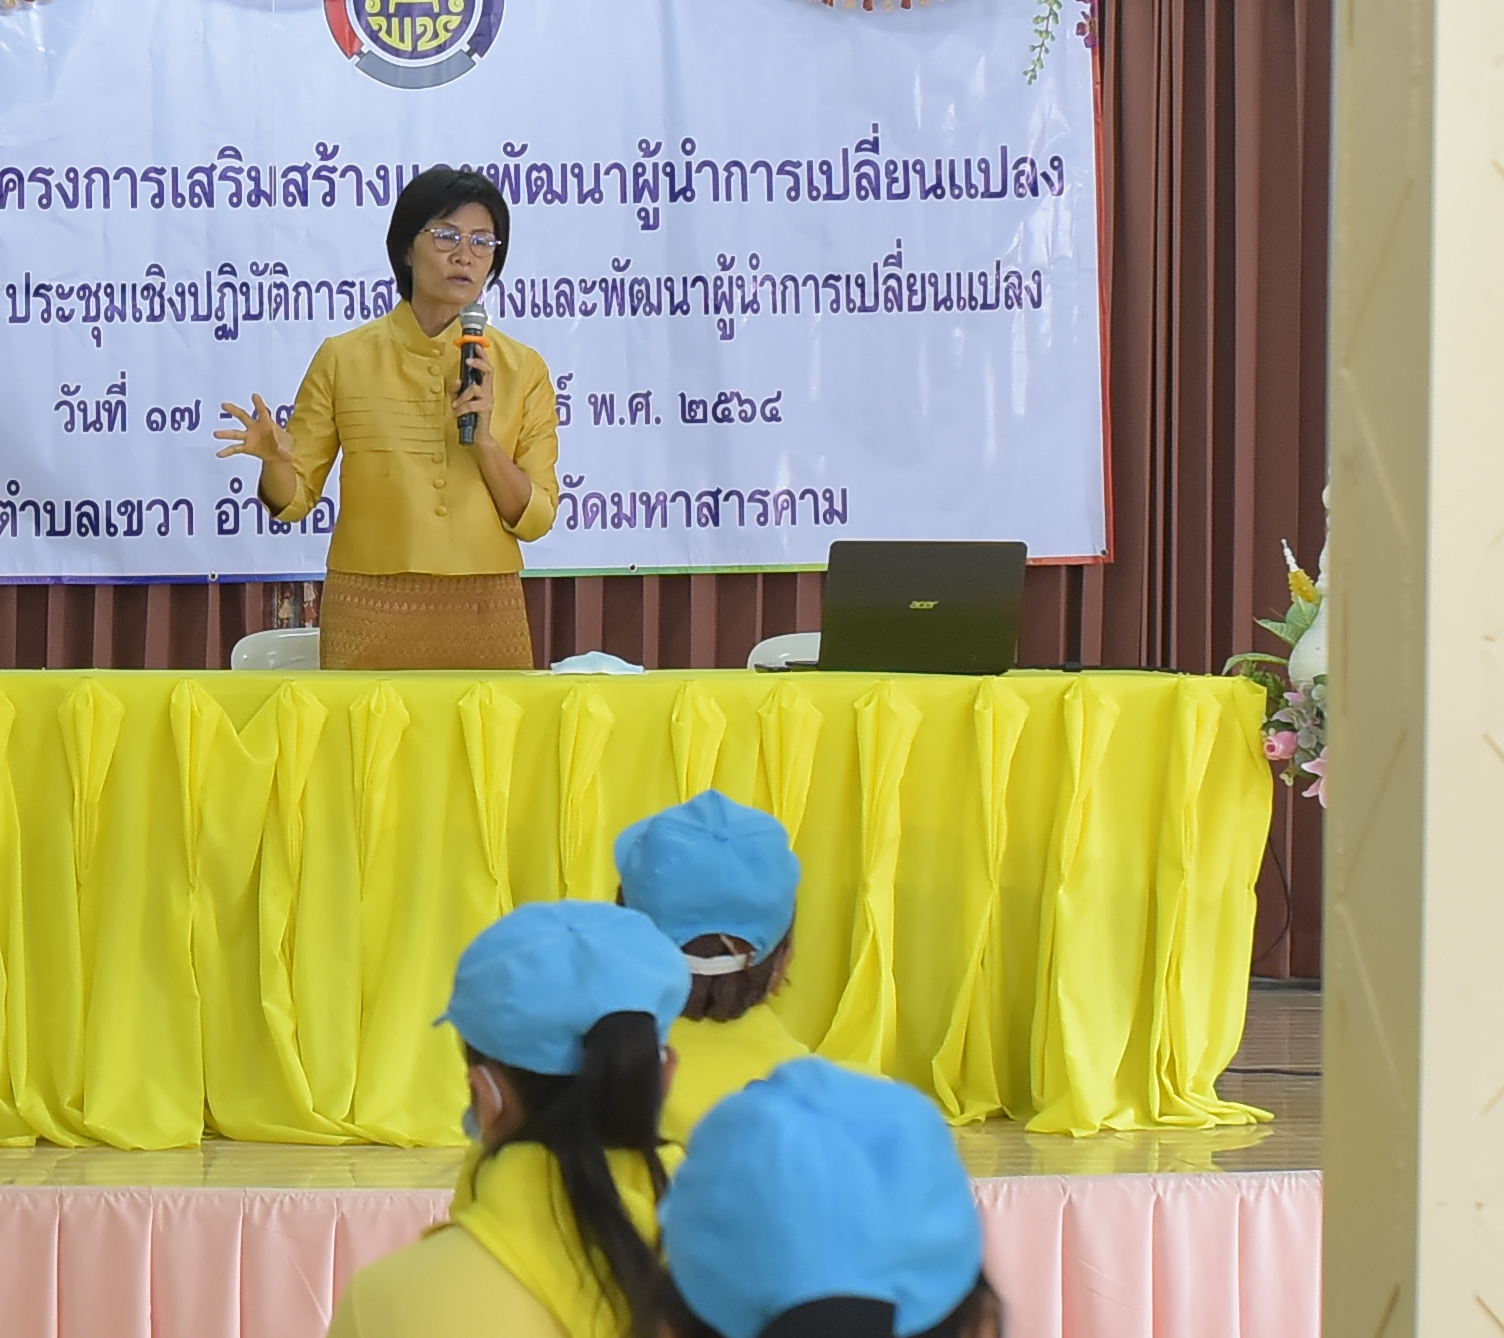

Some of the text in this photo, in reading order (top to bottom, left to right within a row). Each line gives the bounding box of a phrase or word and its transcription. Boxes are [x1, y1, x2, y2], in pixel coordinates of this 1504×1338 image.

[55, 370, 129, 435] วันที่
[146, 399, 202, 432] ๑๗
[587, 390, 663, 427] พ.ศ.
[678, 387, 783, 427] ๒๕๖๔
[908, 599, 939, 611] acer
